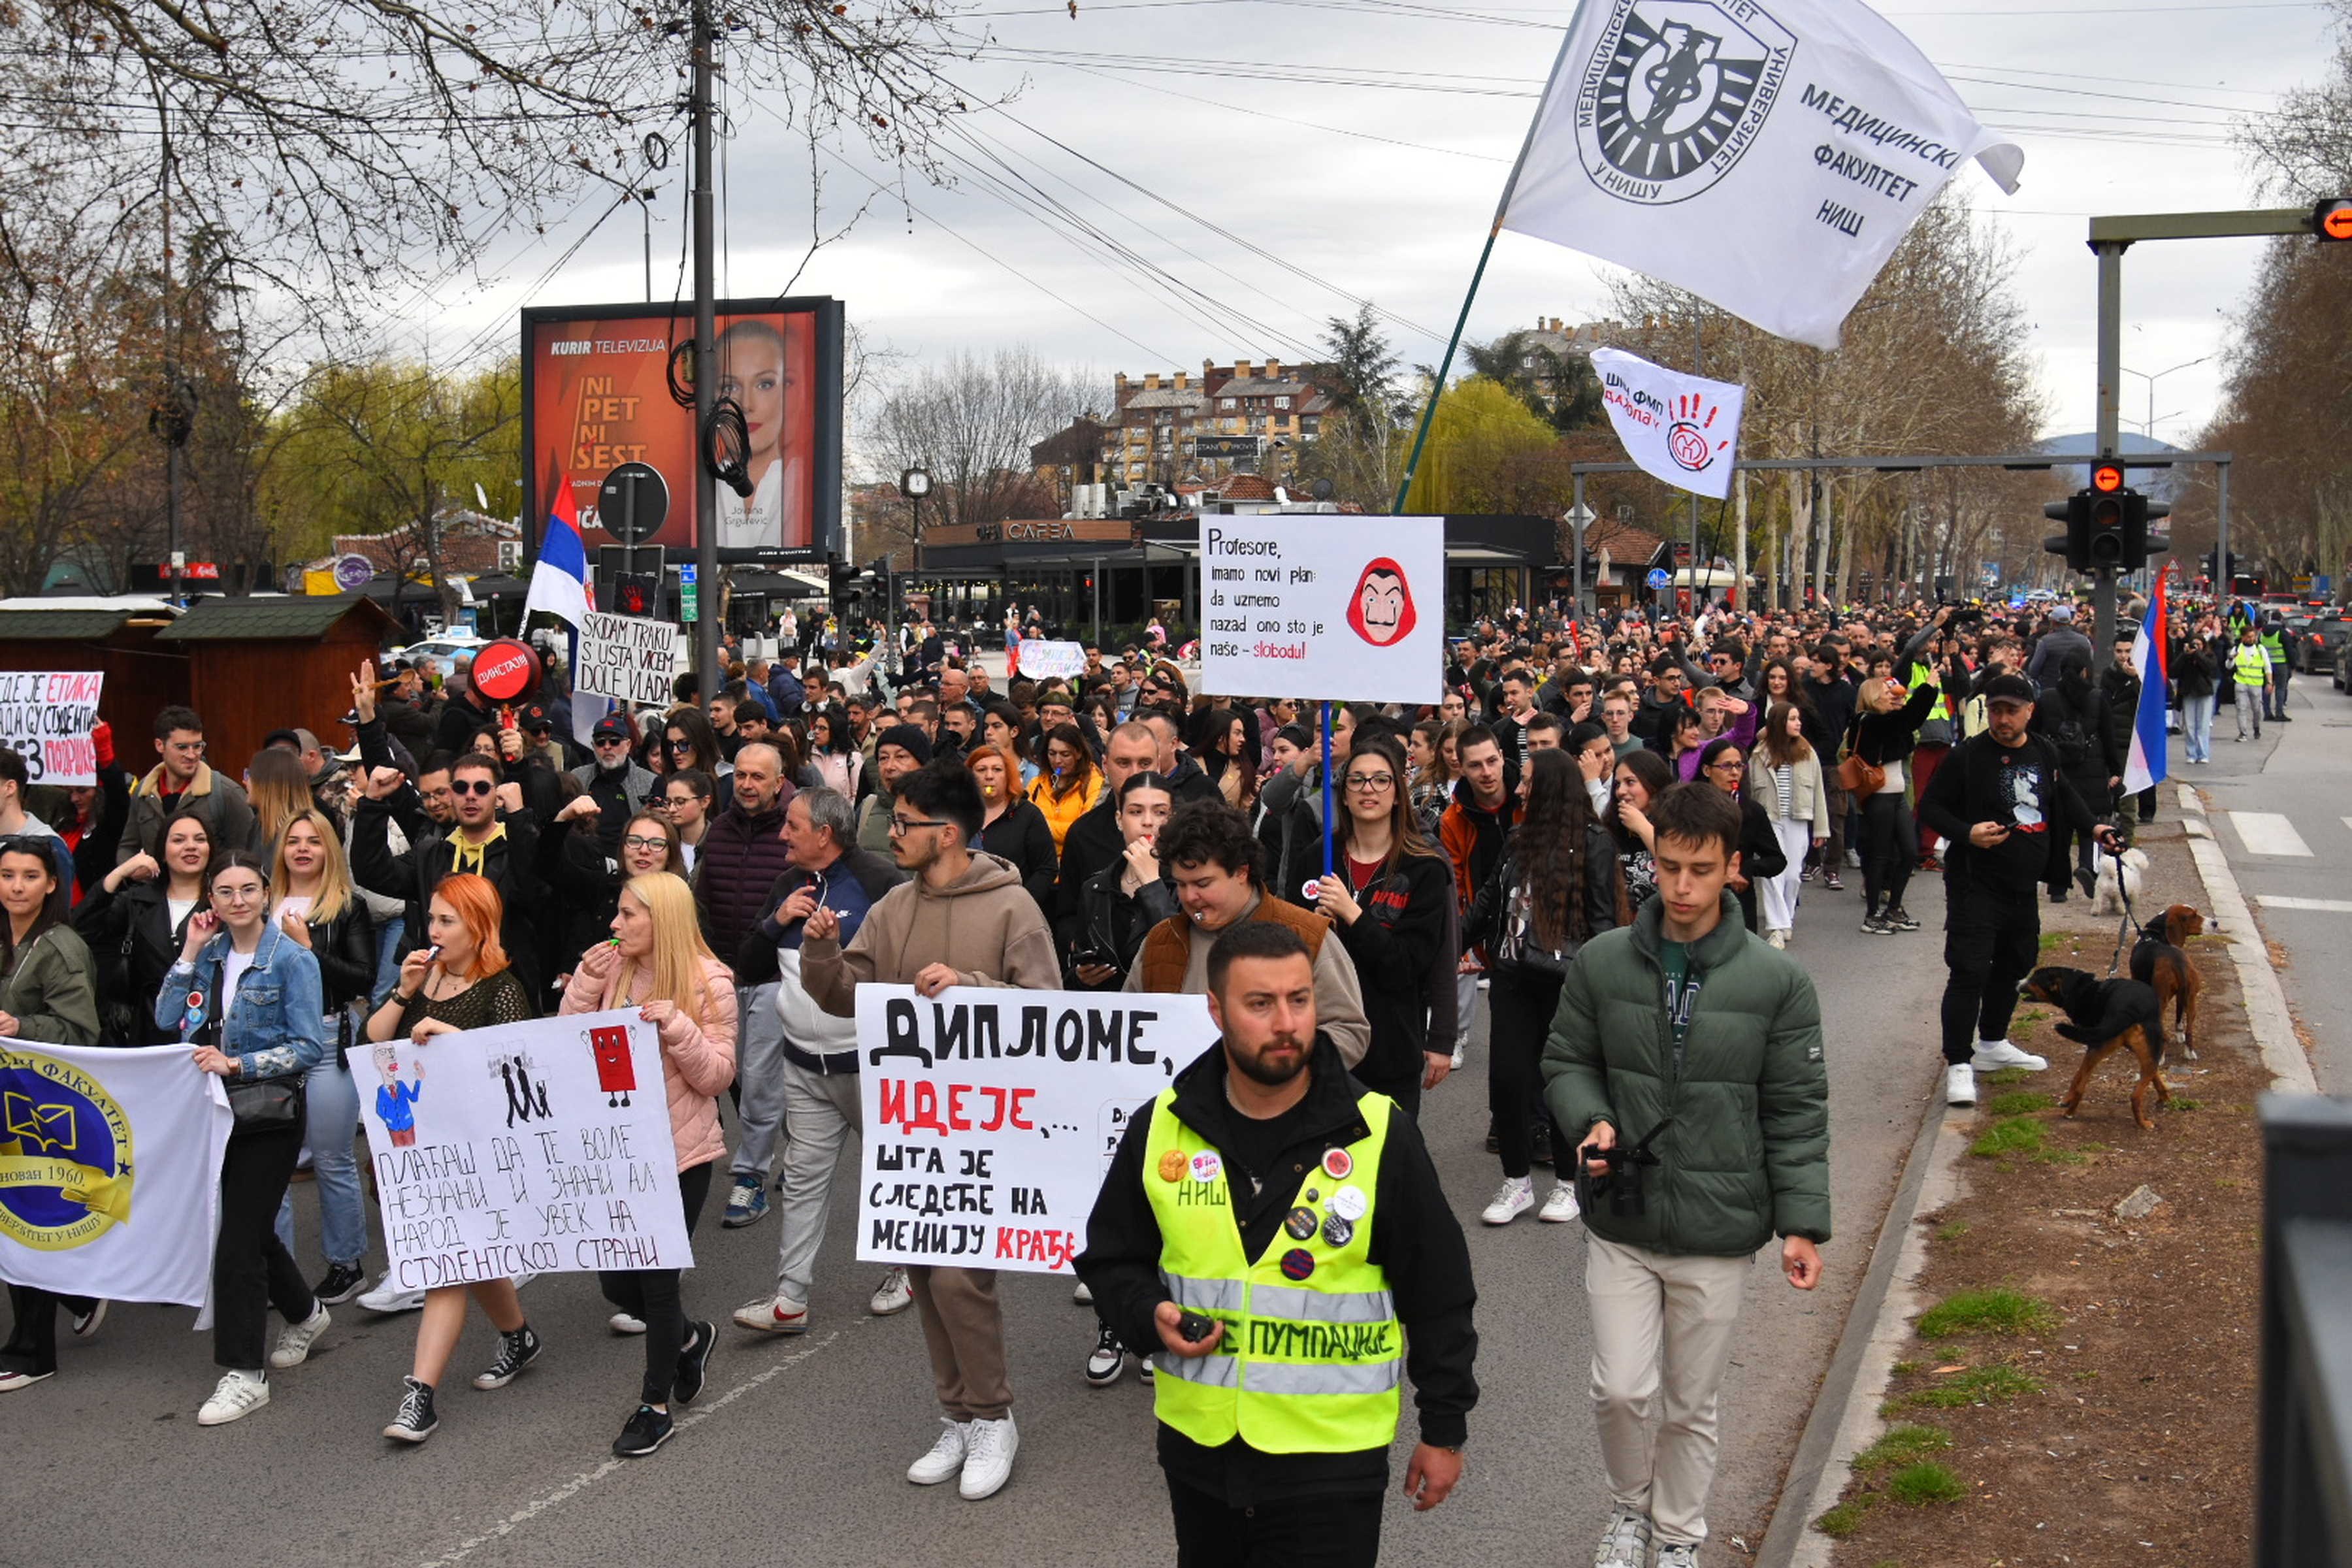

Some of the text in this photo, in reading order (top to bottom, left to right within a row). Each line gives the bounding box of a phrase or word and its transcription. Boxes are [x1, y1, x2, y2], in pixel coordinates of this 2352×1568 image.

[1710, 46, 1789, 175] УНИВЕРЗИТЕТ
[1603, 174, 1662, 199] НИШУ
[1814, 144, 1918, 202] ФАКУЛТЕТ
[1816, 199, 1865, 237] НИШ
[551, 339, 666, 355] KURIR TELEVIZIJA
[587, 377, 612, 395] NI
[583, 397, 640, 421] PET
[580, 425, 606, 444] NI
[1208, 528, 1282, 559] Profesore,
[1211, 566, 1316, 585] imamo novi plan:
[1210, 589, 1280, 608] da uzmemo
[581, 614, 672, 651] SKIDAM TRAKU
[1210, 615, 1247, 632] nazad
[1256, 621, 1281, 632] ono
[1312, 621, 1324, 636] je
[581, 642, 592, 661] S
[1253, 640, 1305, 659] slobodu!
[25, 674, 46, 704] ЈЕ
[46, 674, 100, 702] ЕТИКА
[581, 663, 672, 704] DOLE VLADA
[26, 705, 42, 736] СУ
[869, 998, 1174, 1075] ДИПЛОМЕ,
[42, 1063, 127, 1149] ФАКУЛТЕТ
[378, 1124, 636, 1187] ПЛАЋАШ ДА ТЕ ВОЛЕ
[876, 1145, 994, 1178] ШТА ЈЕ
[48, 1166, 86, 1188] 1960.
[385, 1176, 489, 1222] НЕЗНАНИ
[510, 1173, 529, 1205] И
[546, 1162, 615, 1200] ЗНАНИ
[869, 1182, 1048, 1217] СЛЕДЕЋЕ НА
[0, 1208, 101, 1243] ВЕРЗИТЕТ У НИШУ
[393, 1200, 638, 1256] НАРОД ЈЕ УВЕК НА
[872, 1218, 986, 1255] МЕНИЈУ
[399, 1235, 660, 1290] СТУДЕНТСКОЈ СТРАНИ
[1249, 1319, 1395, 1361] ПУМПАЦИЈЕ
